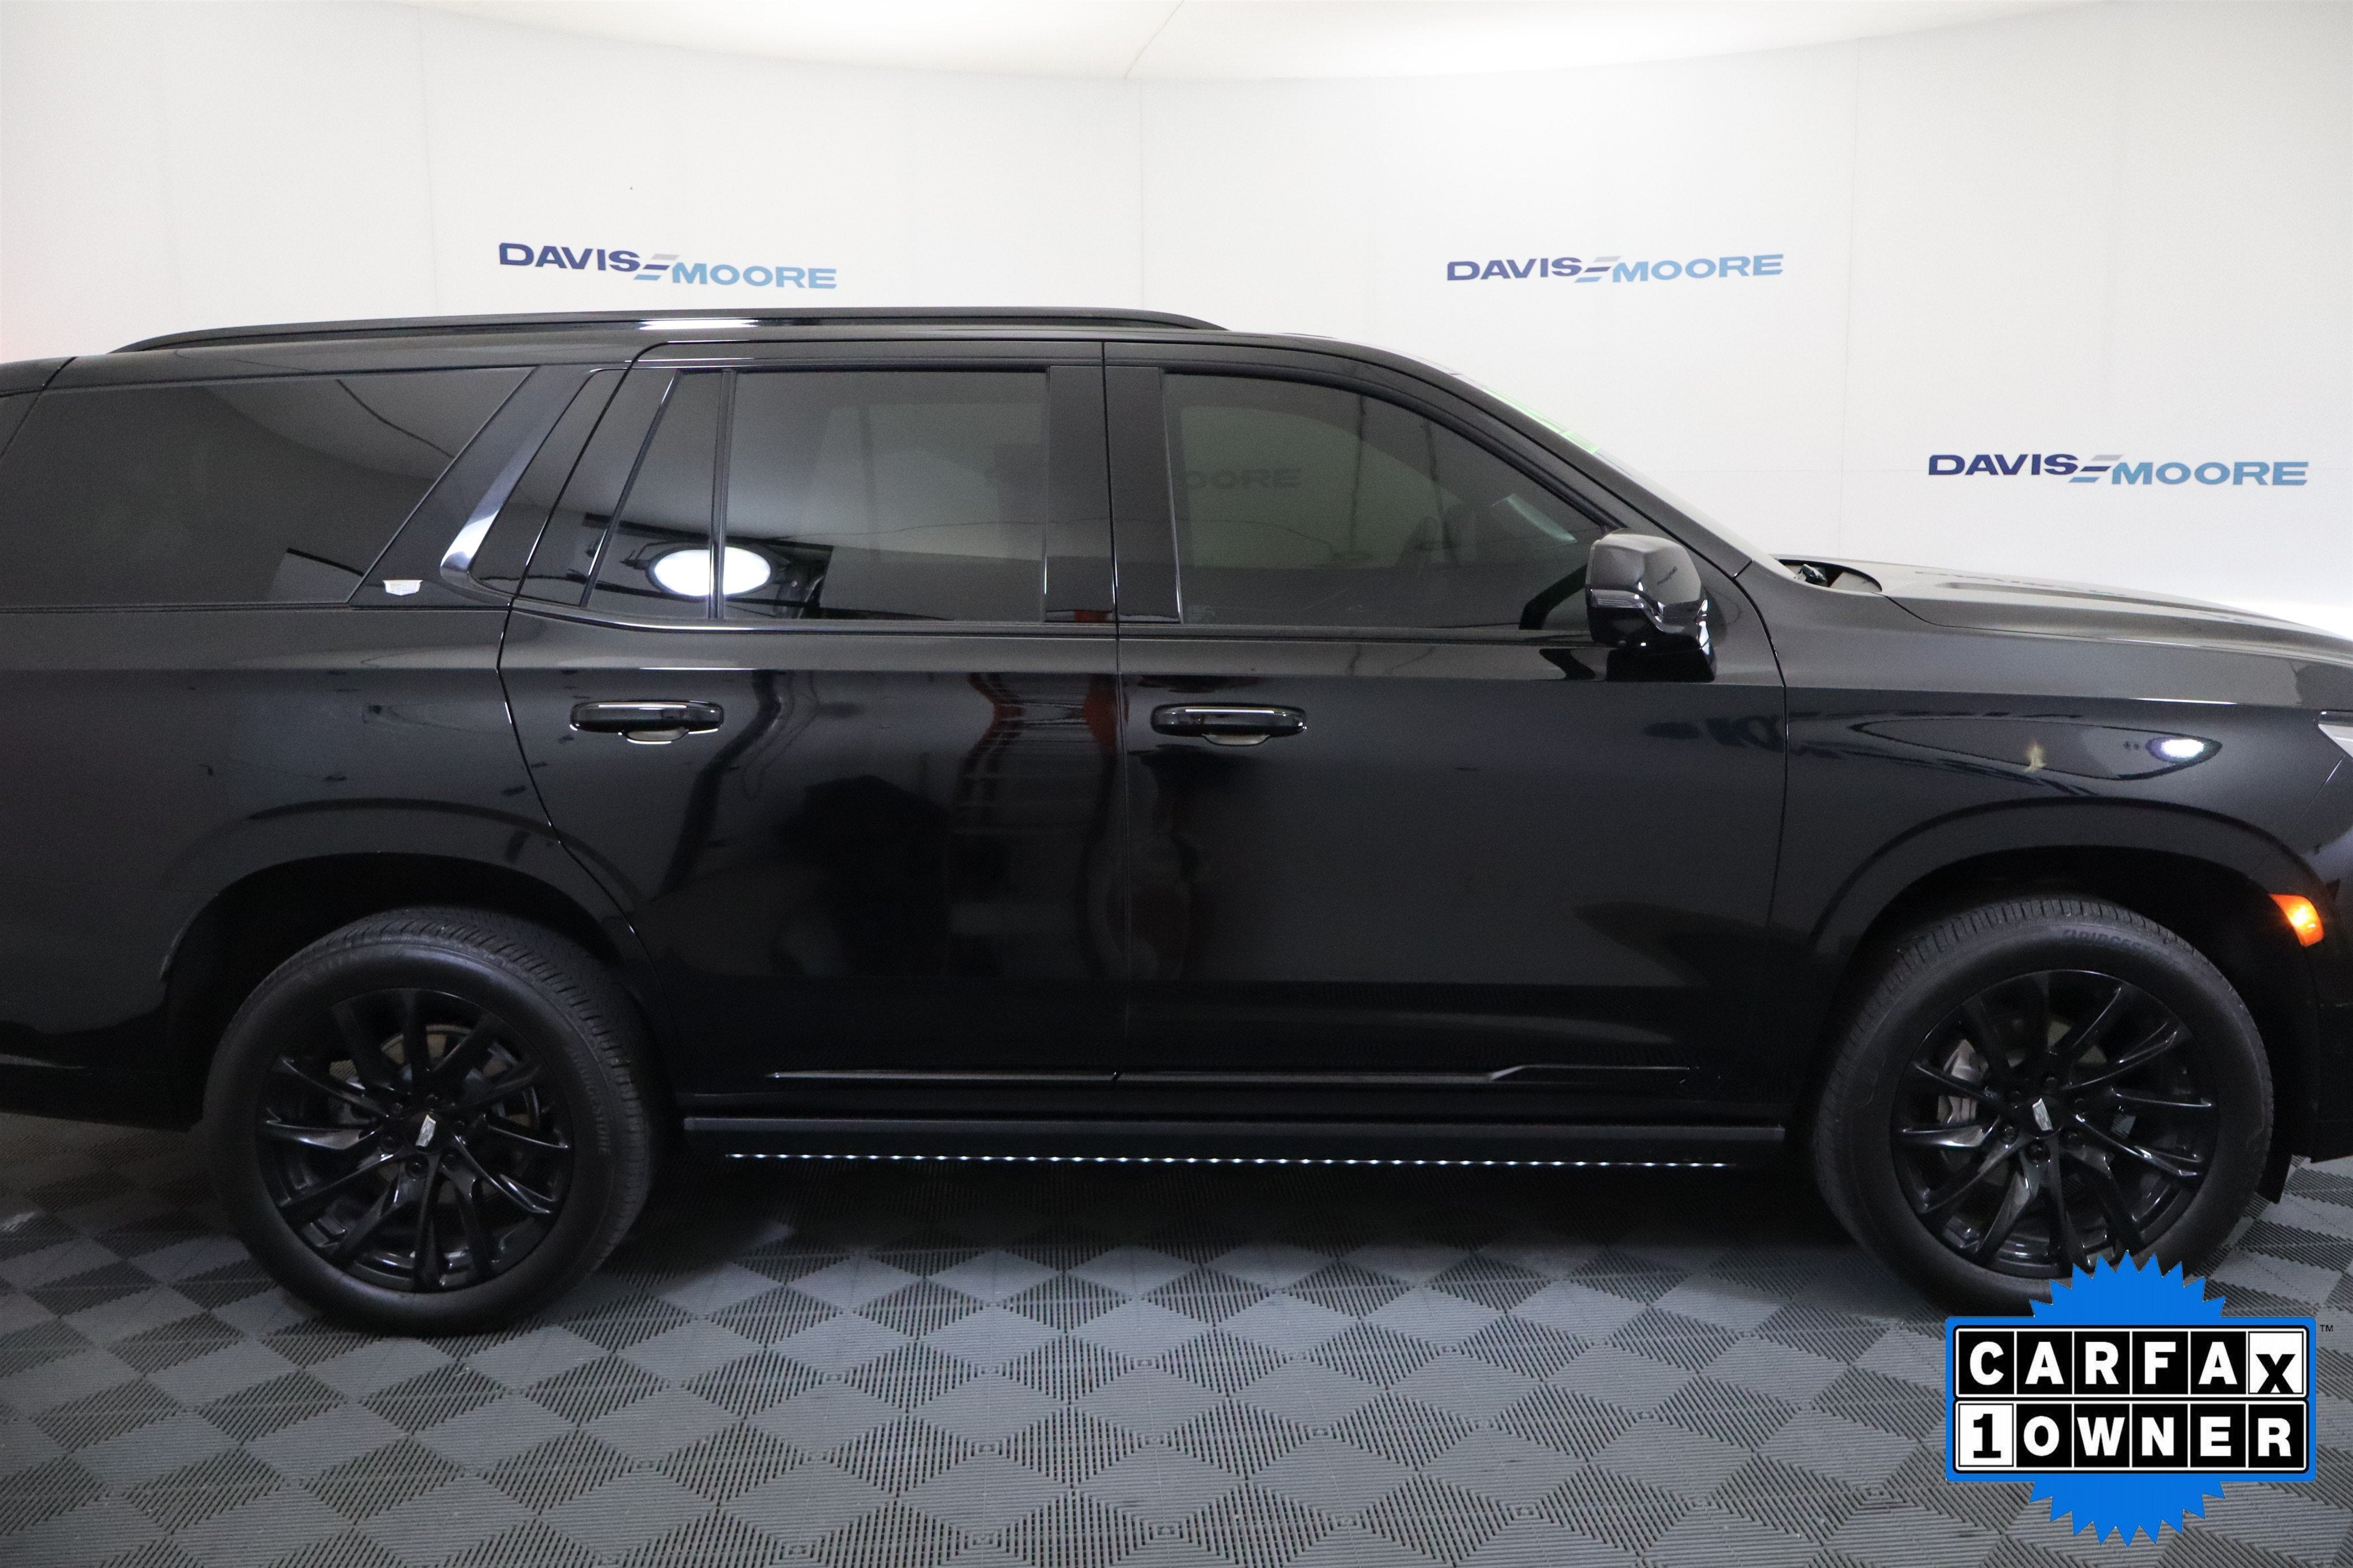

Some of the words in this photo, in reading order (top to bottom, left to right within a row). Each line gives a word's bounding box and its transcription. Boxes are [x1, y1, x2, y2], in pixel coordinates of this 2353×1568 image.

[498, 242, 641, 272] DAVIS
[672, 262, 837, 289] MOORE
[1446, 256, 1583, 281] DAVIS
[1612, 254, 1784, 283] MOORE
[1928, 454, 2079, 476] DAVIS
[2111, 461, 2309, 486] MOORE
